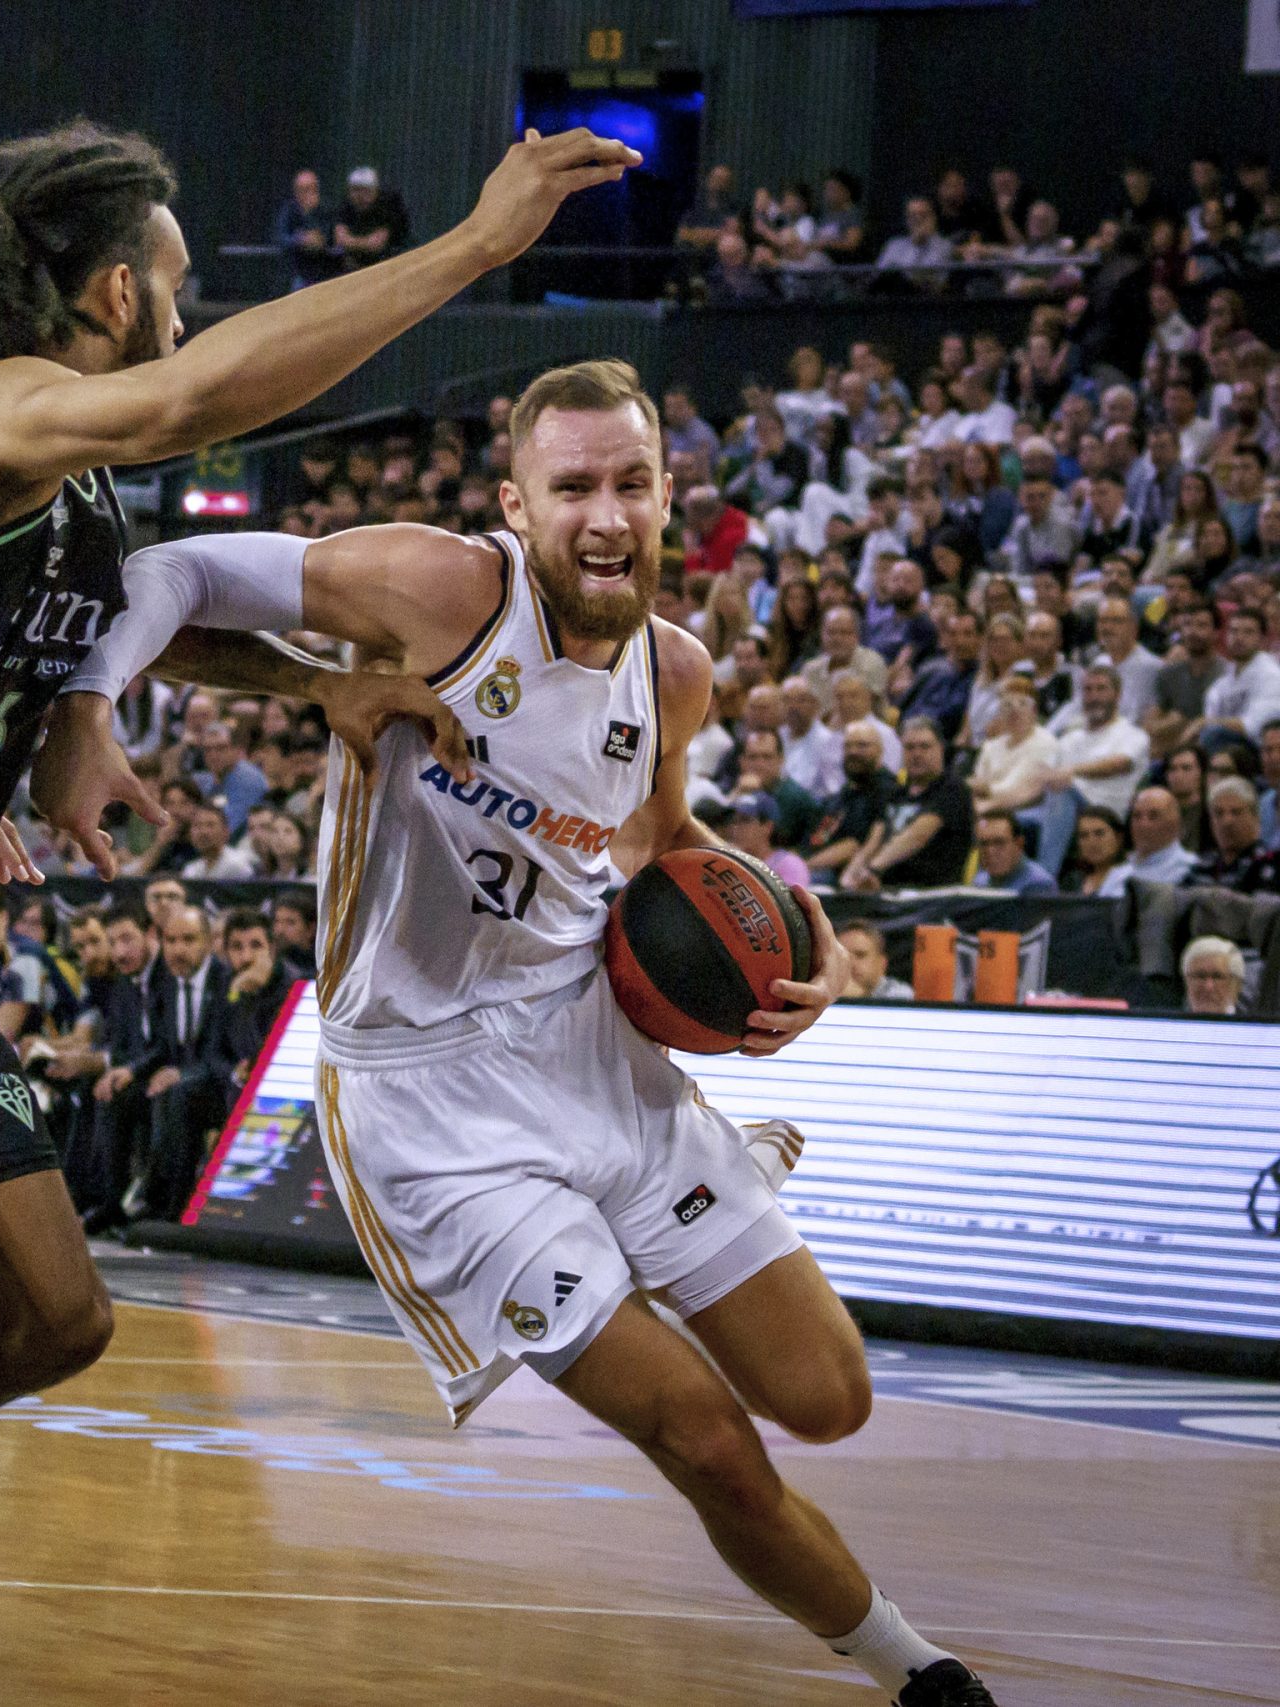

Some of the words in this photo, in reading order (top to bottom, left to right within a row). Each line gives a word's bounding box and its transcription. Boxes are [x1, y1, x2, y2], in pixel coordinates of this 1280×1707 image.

[419, 763, 616, 855] AUTOHERO
[465, 848, 545, 922] 31
[702, 859, 784, 956] LEGACY
[681, 1198, 708, 1221] acb
